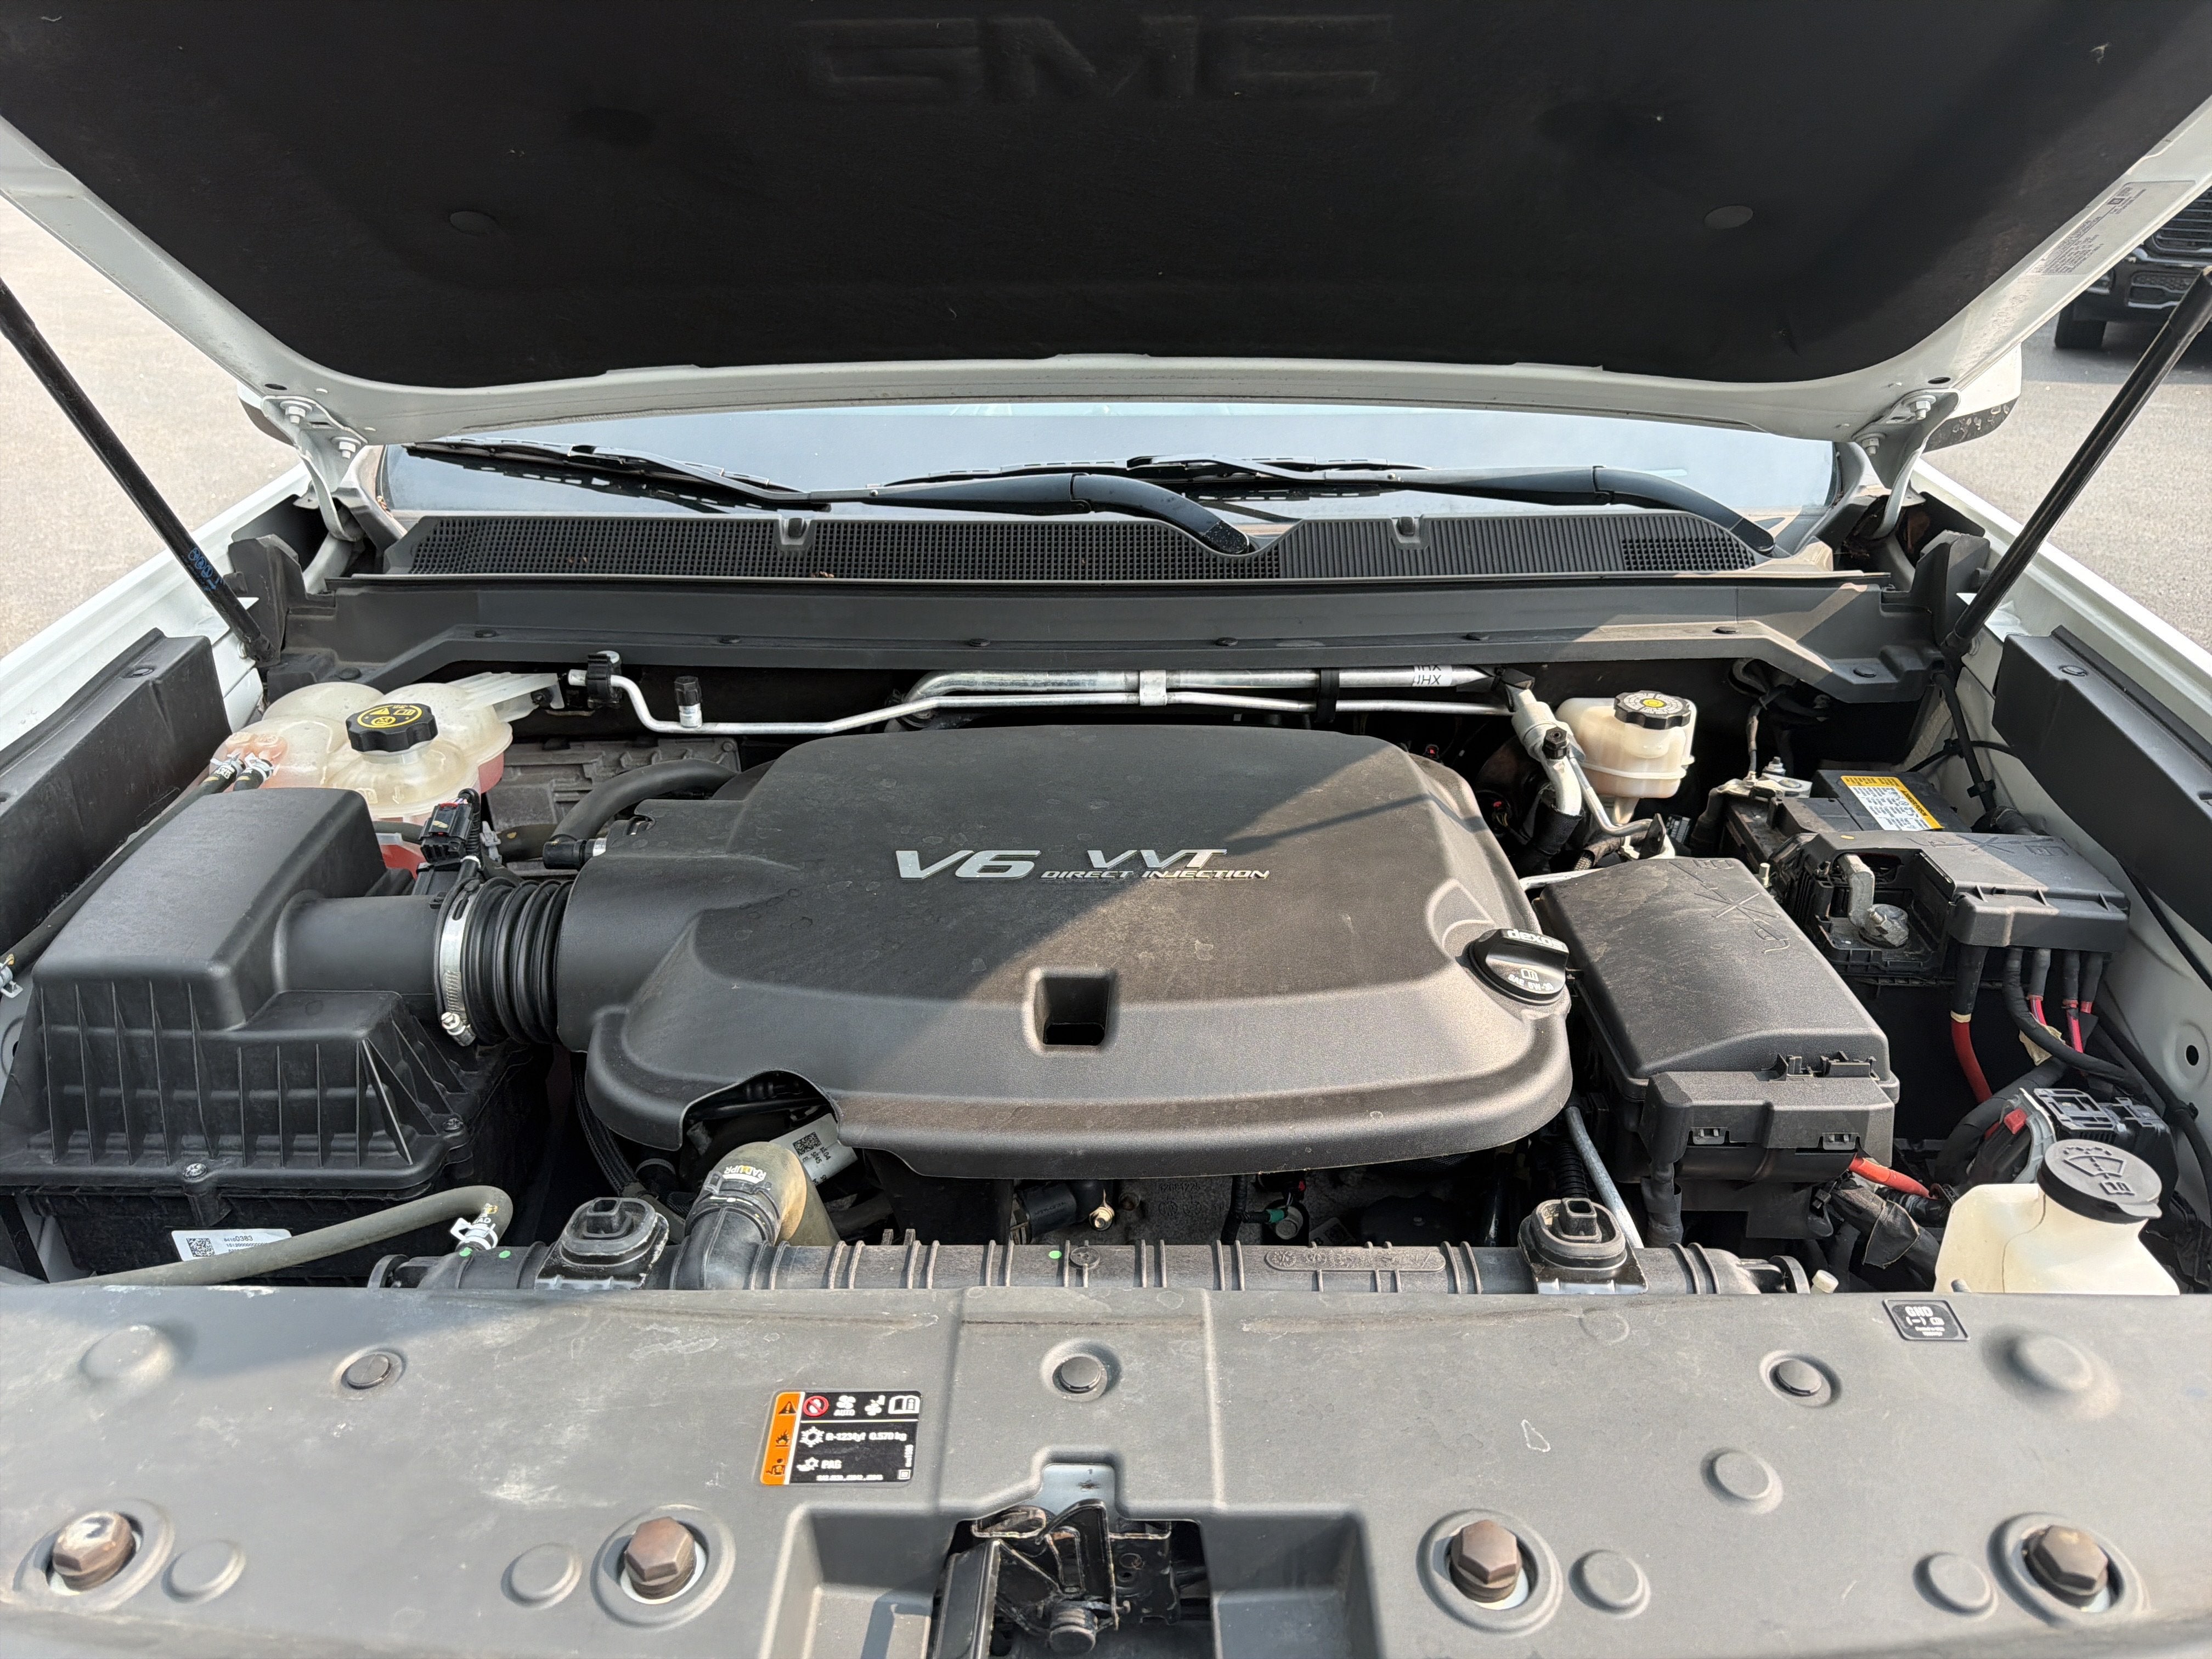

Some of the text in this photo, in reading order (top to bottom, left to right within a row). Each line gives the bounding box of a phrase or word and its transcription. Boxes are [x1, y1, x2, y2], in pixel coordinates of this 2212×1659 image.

[794, 14, 1396, 106] GMC
[895, 850, 1041, 879] V6
[1087, 849, 1227, 869] VVT
[1041, 870, 1271, 879] DIRECT INJECTION
[1507, 929, 1563, 950] dexos
[1508, 974, 1525, 987] SAE
[744, 1166, 767, 1181] RAD
[1905, 1306, 1933, 1317] GND
[894, 1431, 907, 1441] kg
[821, 1460, 842, 1469] PAG
